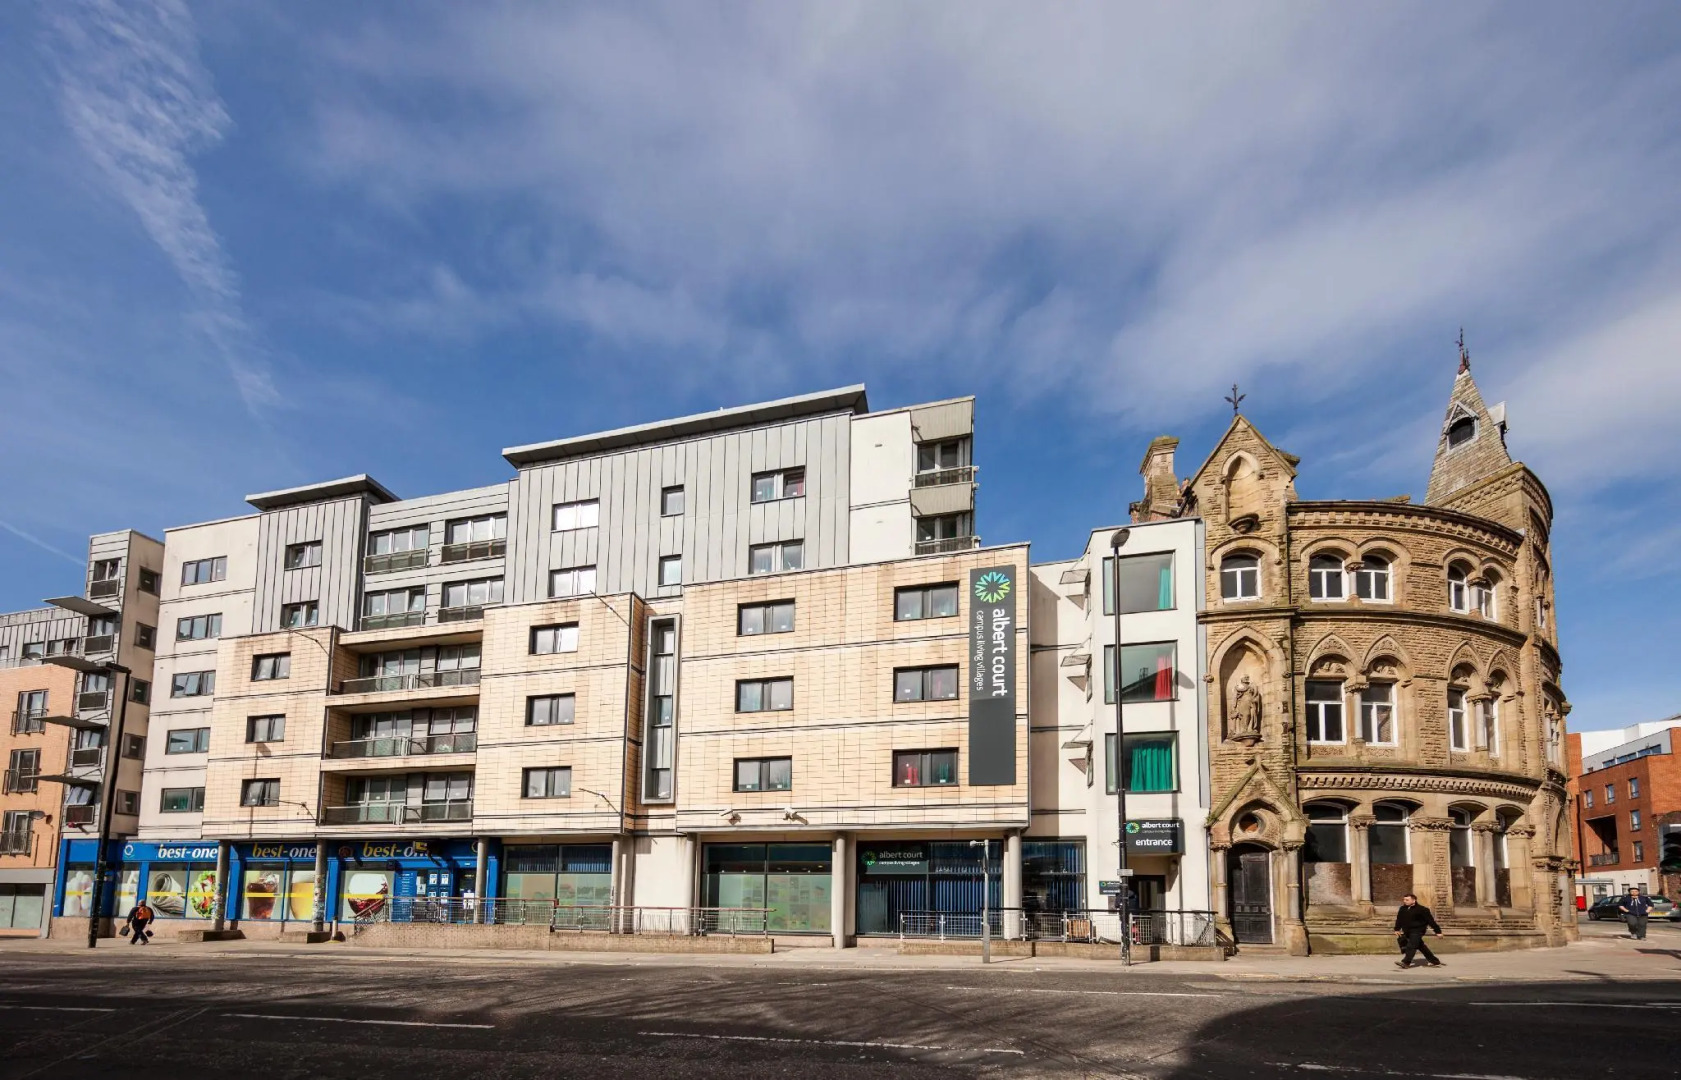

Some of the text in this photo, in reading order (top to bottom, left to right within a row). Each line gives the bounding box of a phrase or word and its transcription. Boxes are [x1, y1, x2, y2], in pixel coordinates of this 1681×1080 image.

[974, 610, 986, 691] campus living villages
[992, 608, 1011, 697] albert court
[1141, 821, 1161, 829] albert
[363, 841, 433, 858] best-o
[1135, 838, 1173, 846] entrance
[158, 843, 218, 858] best-one
[252, 842, 317, 858] best-one
[879, 850, 923, 859] albert court
